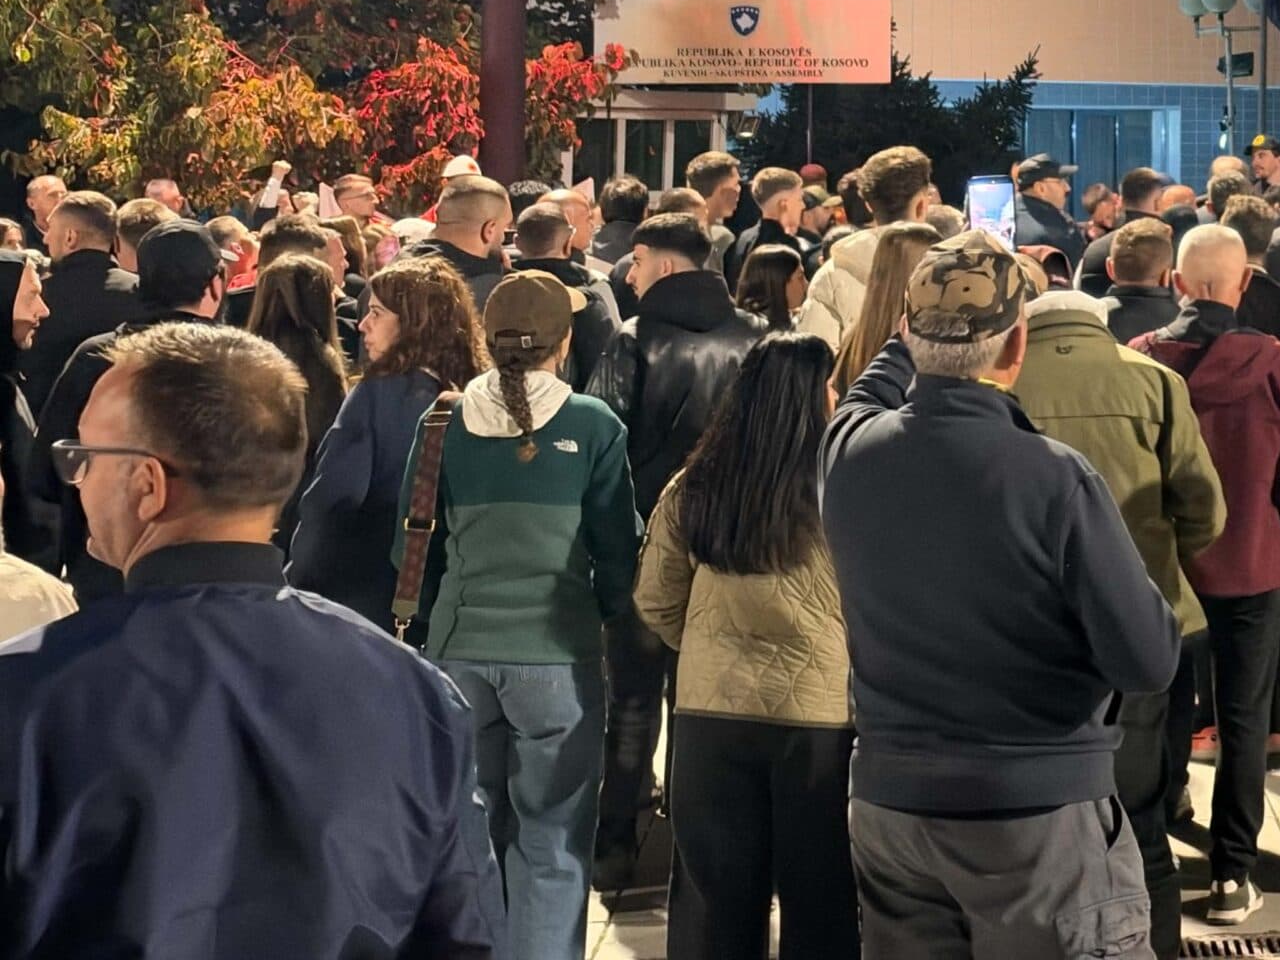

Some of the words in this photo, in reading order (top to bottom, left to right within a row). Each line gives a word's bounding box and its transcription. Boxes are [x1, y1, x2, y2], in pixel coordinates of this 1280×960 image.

[677, 48, 742, 57] REPUBLIKA
[760, 46, 812, 57] KOSOVËS
[745, 58, 801, 68] REPUBLIC
[804, 59, 819, 68] OF
[822, 58, 869, 68] KOSOVO
[663, 70, 707, 78] KUVENDI
[775, 69, 823, 78] ASSEMBLY
